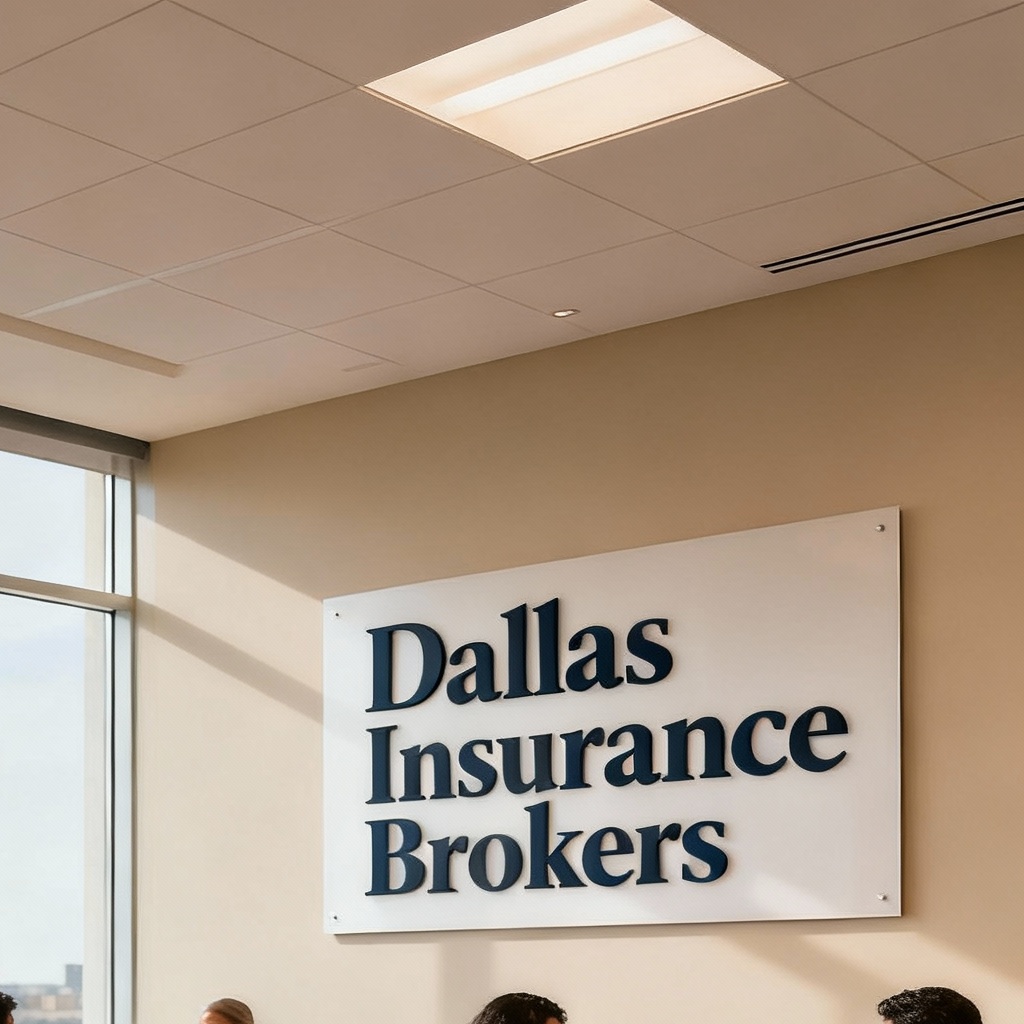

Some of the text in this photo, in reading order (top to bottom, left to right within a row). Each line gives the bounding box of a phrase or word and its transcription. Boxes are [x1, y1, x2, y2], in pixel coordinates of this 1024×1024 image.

[365, 598, 674, 713] Dallas
[365, 706, 849, 805] Insurance
[365, 801, 729, 897] Brokers
